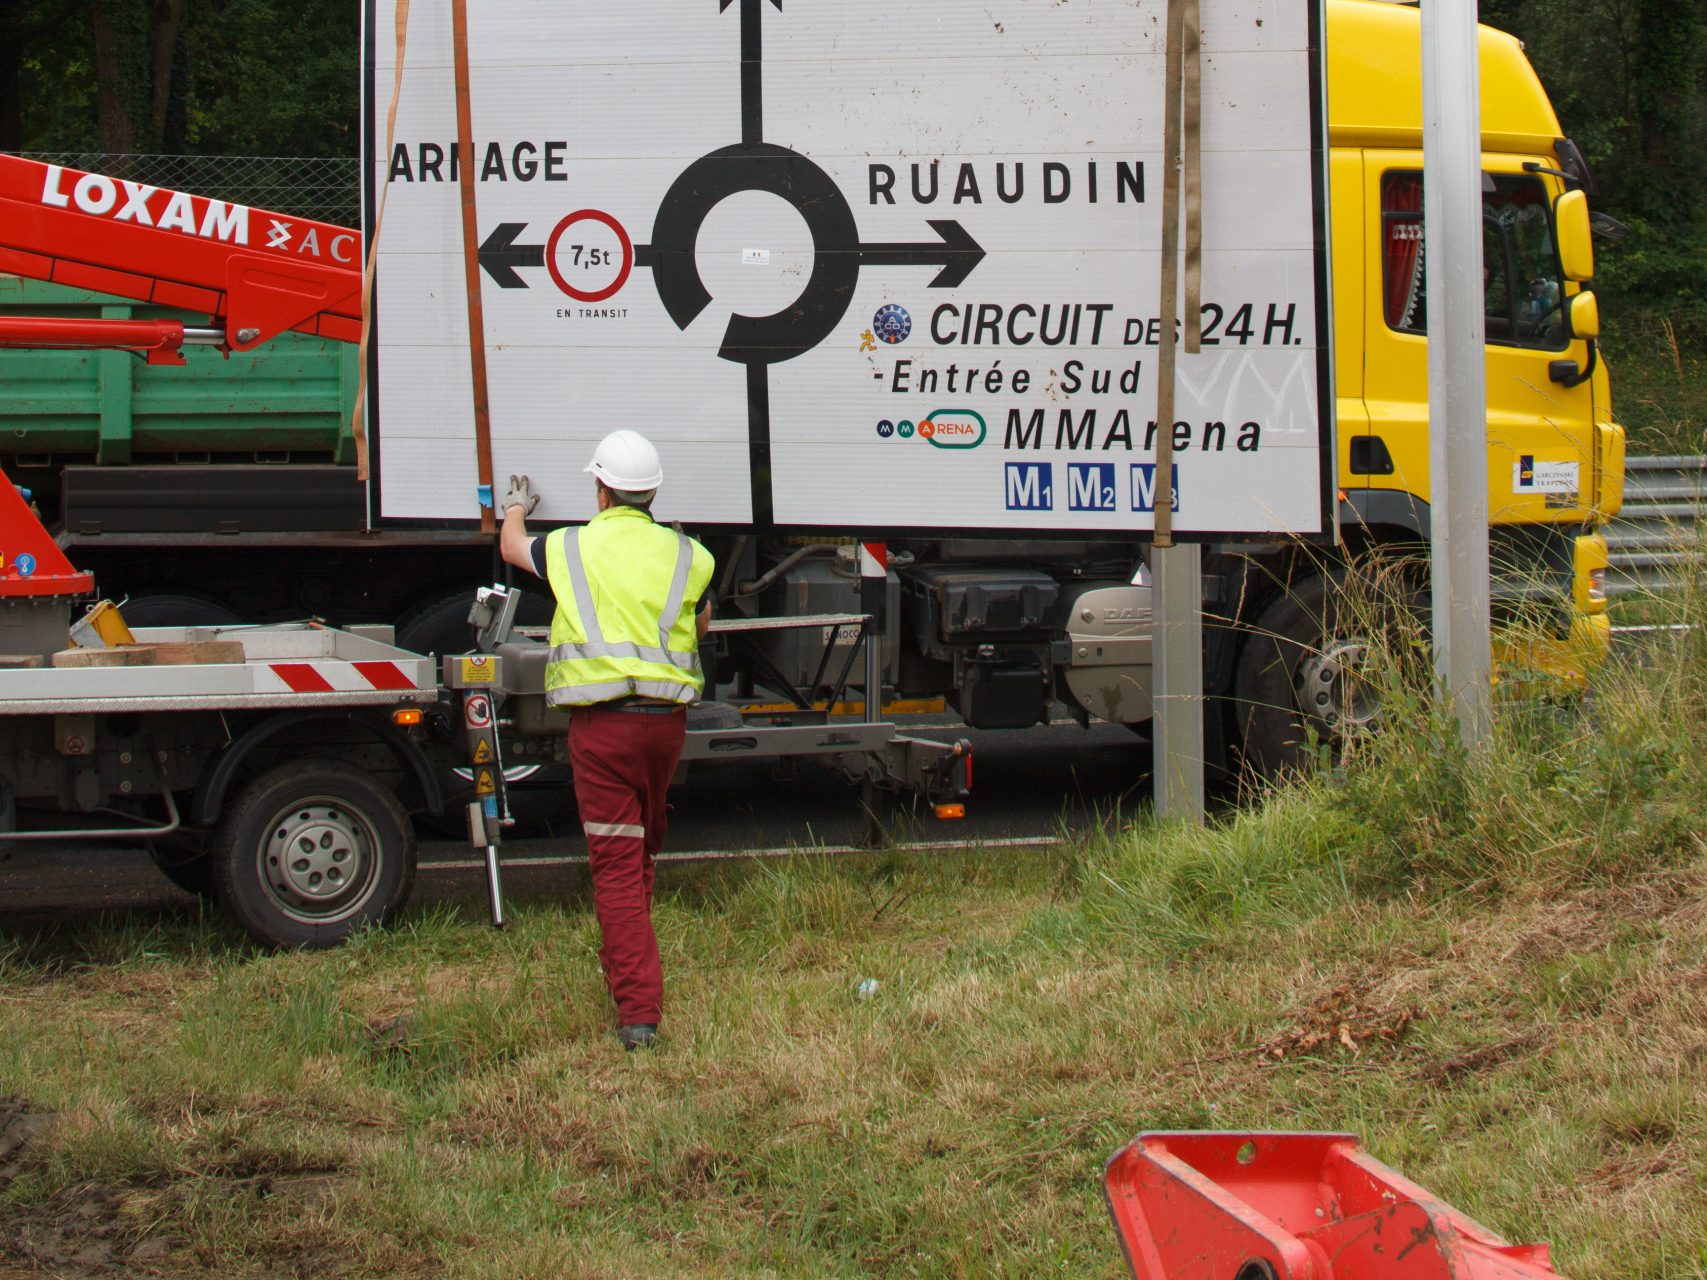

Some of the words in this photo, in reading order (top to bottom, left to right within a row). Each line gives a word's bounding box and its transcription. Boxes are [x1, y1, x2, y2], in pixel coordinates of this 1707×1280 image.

[41, 164, 250, 246] LOXAM
[868, 161, 1146, 205] RUAUDIN
[556, 309, 571, 318] EN
[579, 309, 628, 318] TRANSIT
[930, 302, 1114, 346] CIRCUIT
[1200, 302, 1255, 345] 24
[874, 359, 1031, 394] -Entrée
[1060, 359, 1142, 395] Sud
[1003, 408, 1262, 453] MMArena
